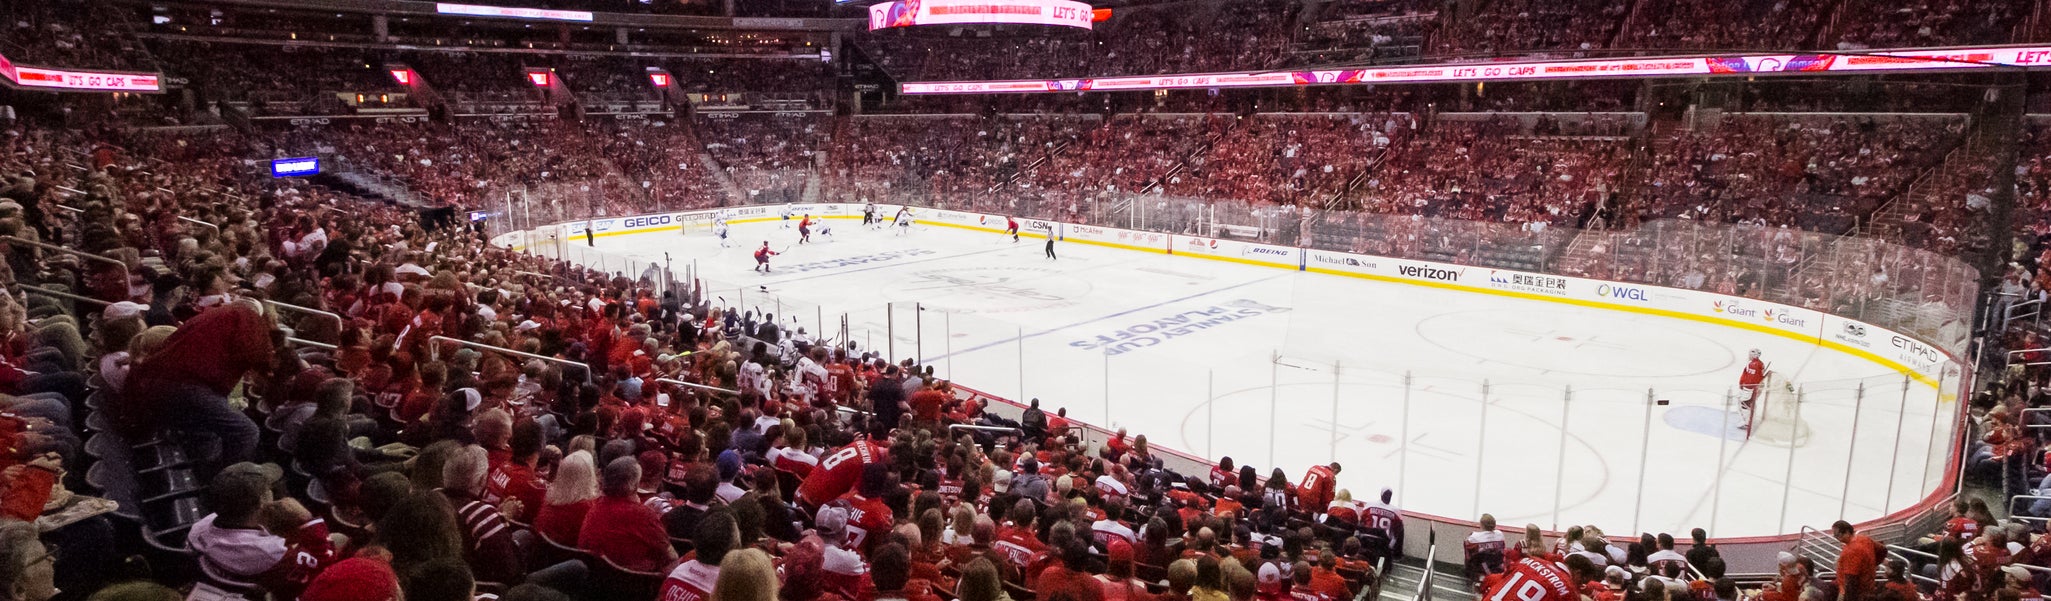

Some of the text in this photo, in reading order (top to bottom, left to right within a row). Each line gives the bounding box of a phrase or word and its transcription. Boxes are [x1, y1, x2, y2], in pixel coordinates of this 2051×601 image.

[1053, 6, 1075, 19] LET'S
[1080, 10, 1088, 22] GO
[1453, 68, 1477, 76] LET'S
[1484, 67, 1501, 76] GO
[1509, 66, 1536, 75] CAPS
[89, 76, 101, 86] GO
[106, 77, 125, 87] CAPS
[624, 215, 671, 228] GEICO
[1079, 227, 1104, 235] McAfee
[1253, 247, 1289, 256] BOEING
[1314, 254, 1377, 269] Michael Son
[1399, 265, 1458, 282] verizon
[1527, 286, 1567, 296] PACKAGING
[1612, 286, 1648, 301] WGL
[1727, 304, 1756, 317] Giant
[1777, 313, 1805, 327] Giant
[1069, 306, 1228, 350] PLAYOFFS
[1103, 308, 1263, 356] STANLEY CUP
[1891, 335, 1938, 363] ETIHAD
[822, 446, 858, 471] 8
[1304, 472, 1317, 490] 8
[1372, 515, 1392, 529] 19
[1520, 557, 1570, 596] BACKSTROM
